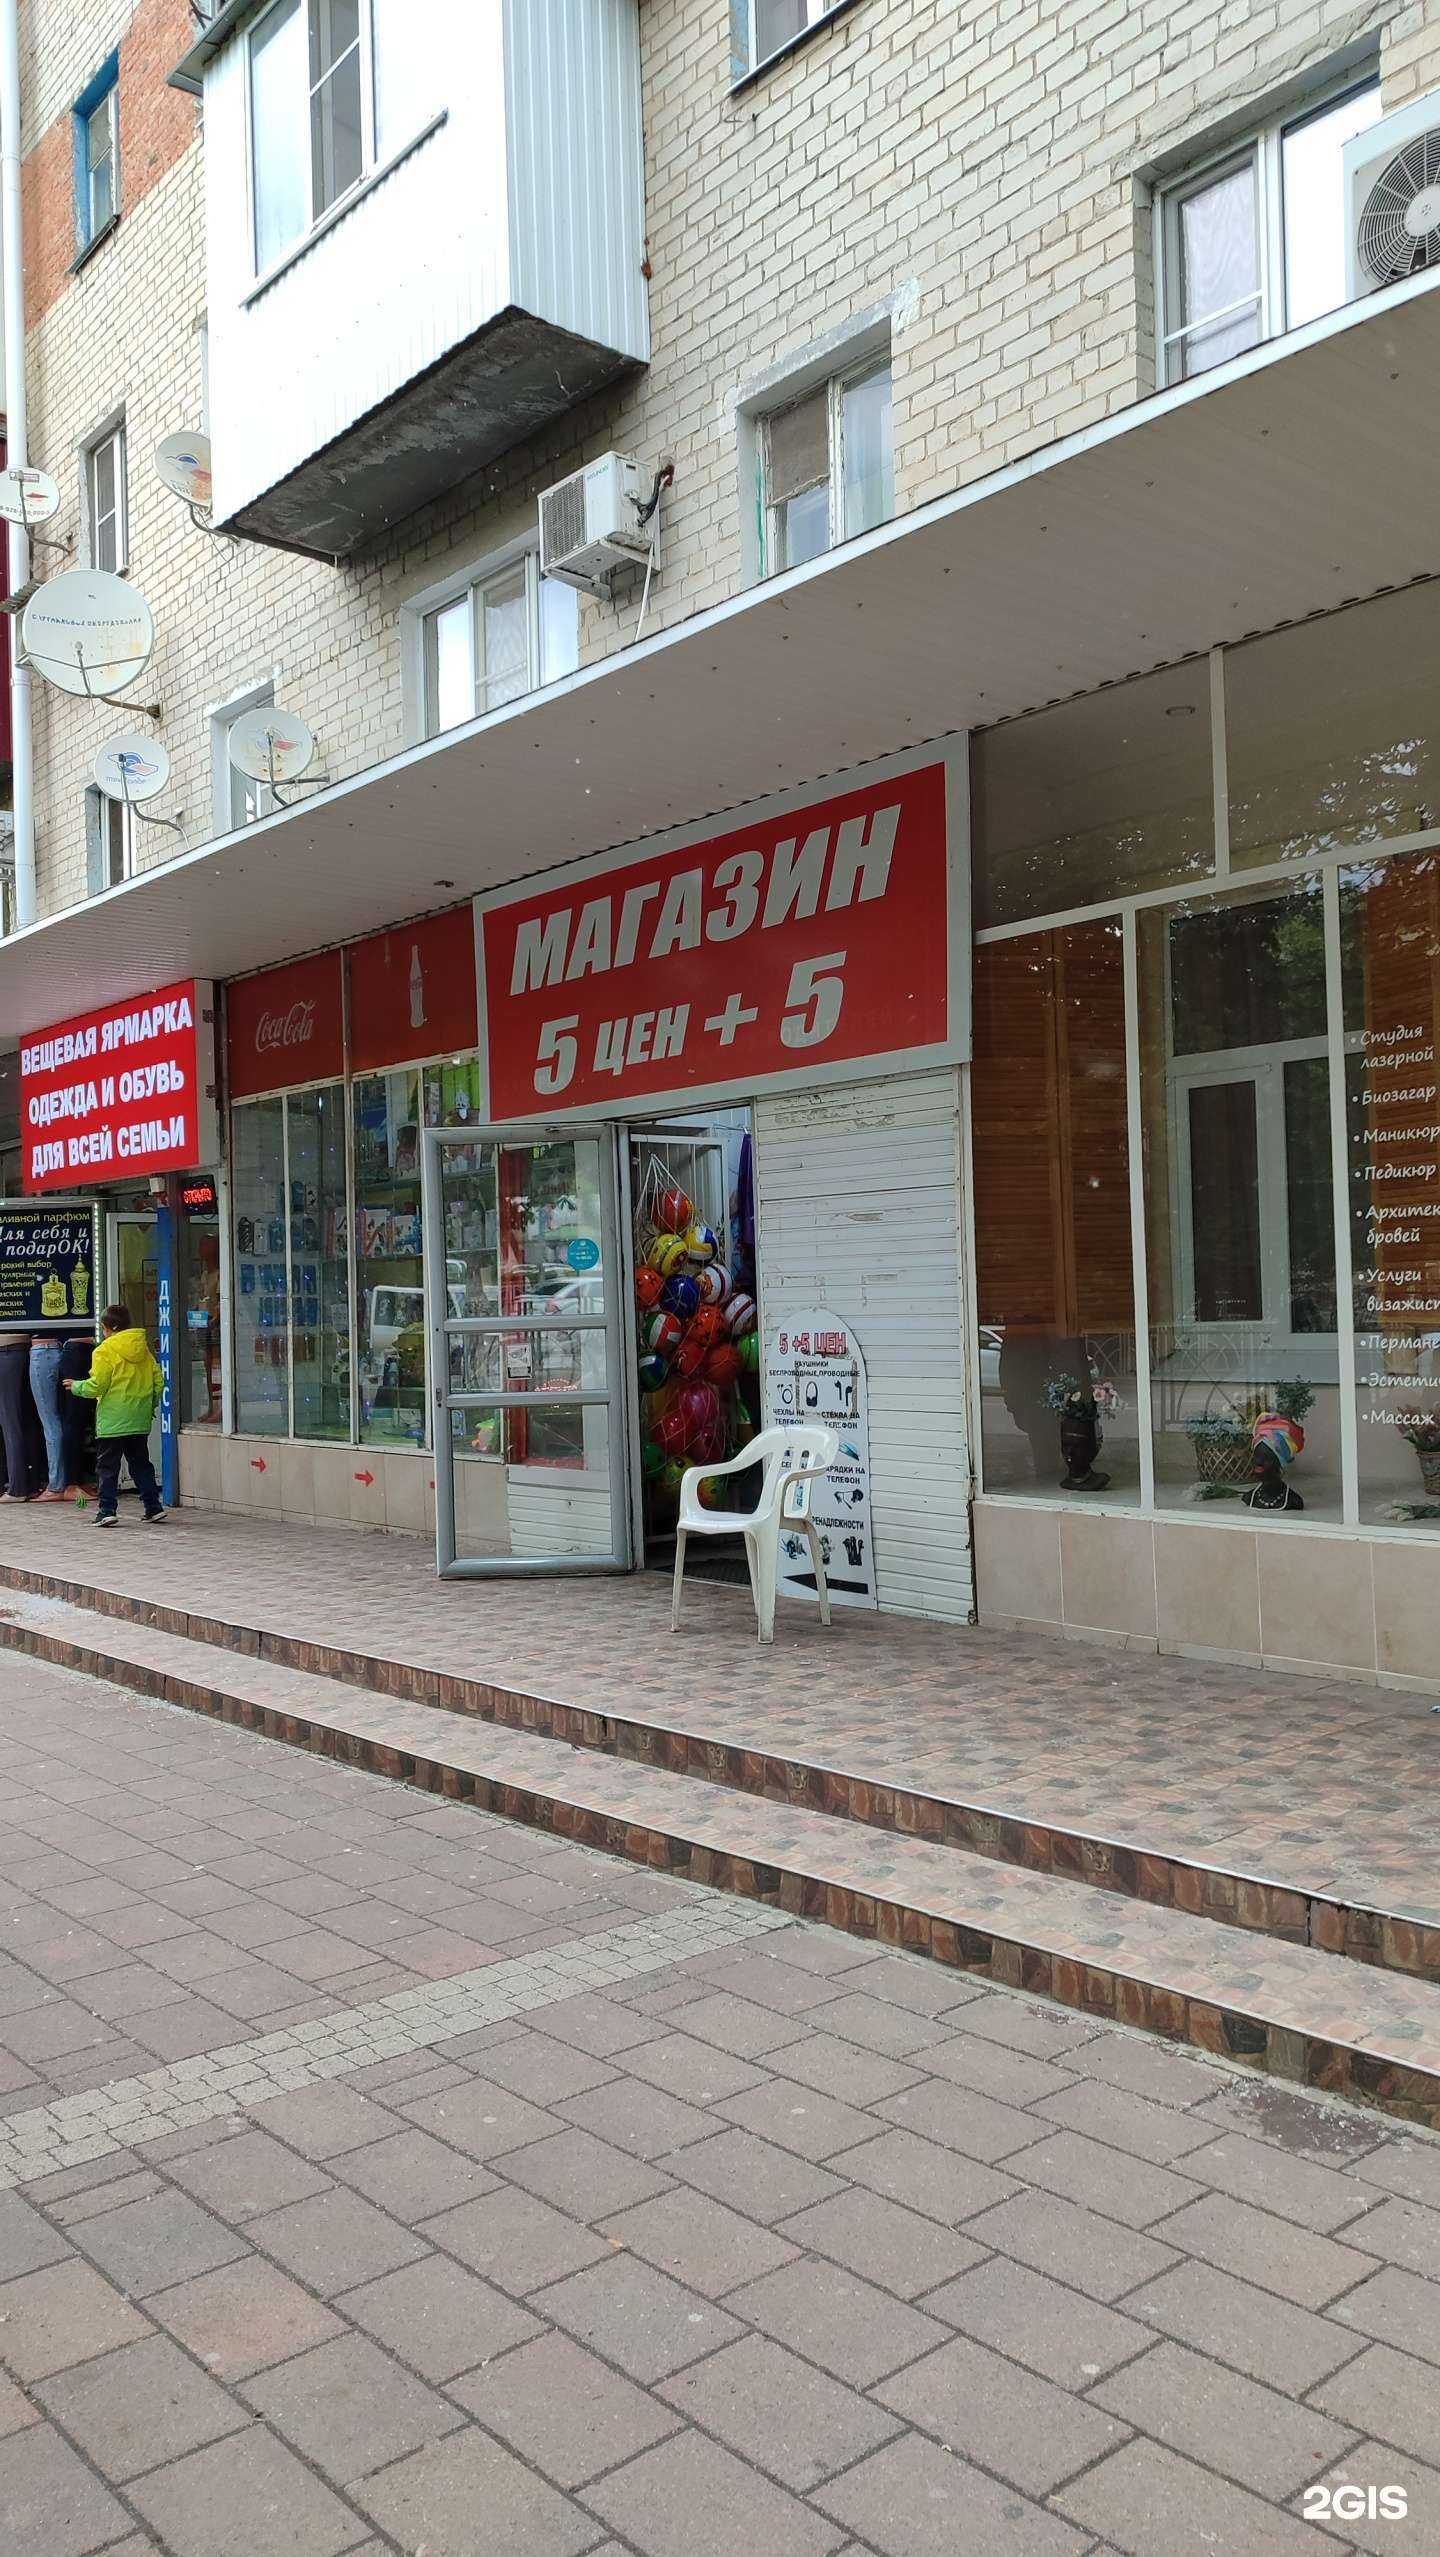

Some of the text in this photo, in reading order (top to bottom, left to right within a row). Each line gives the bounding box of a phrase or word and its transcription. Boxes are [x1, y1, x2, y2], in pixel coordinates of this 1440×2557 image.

[509, 803, 902, 996] МАГАЗИН
[533, 1014, 580, 1097] 5
[592, 1003, 691, 1077] ЦЕН
[779, 950, 847, 1049] 5
[21, 996, 194, 1077] ВЕЩЕВАЯ ЯРМАРКА
[1360, 1024, 1424, 1046] Студия
[1360, 1045, 1435, 1070] лазерной
[28, 1059, 185, 1129] ОДЕЖДА И ОБУВЬ
[1361, 1085, 1437, 1106] Биозагар
[1363, 1125, 1440, 1145] Маникюр
[31, 1114, 186, 1179] ДЛЯ ВСЕЙ СЕМЬИ
[1364, 1162, 1437, 1181] Педикюр
[43, 1212, 90, 1224] парфюм
[32, 1224, 70, 1240] себя
[78, 1227, 88, 1238] и
[1366, 1226, 1421, 1249] бровей
[1366, 1267, 1422, 1286] Услуги
[779, 1332, 789, 1356] 5
[814, 1331, 847, 1358] ЦЕН
[158, 1280, 172, 1434] ДЖИНСЫ
[794, 1360, 829, 1368] НАУШНИКИ
[1368, 1372, 1440, 1387] Эстети
[772, 1408, 805, 1416] ЧЕХЛЫ НА
[1370, 1408, 1436, 1426] Массаж
[825, 1465, 866, 1475] АРЯДКИ НА
[826, 1475, 861, 1485] ТЕЛЕФОН
